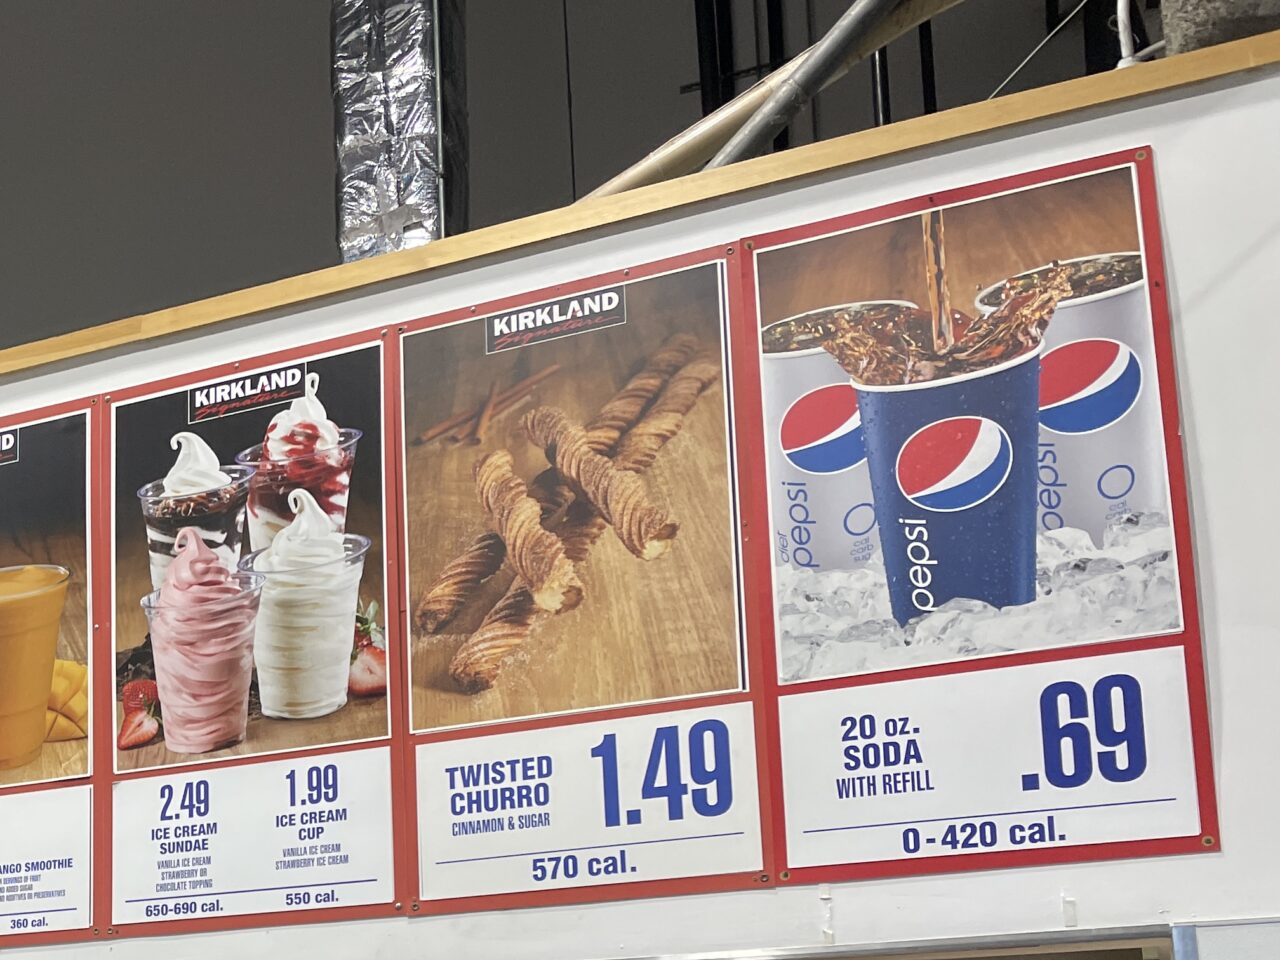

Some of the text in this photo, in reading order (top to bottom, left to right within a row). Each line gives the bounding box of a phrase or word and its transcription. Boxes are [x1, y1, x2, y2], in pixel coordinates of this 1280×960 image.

[493, 291, 619, 337] KIRKLAND
[195, 368, 301, 408] KIRKLAND
[781, 481, 820, 568] pepsi
[853, 536, 870, 547] cal
[898, 517, 938, 612] pepsi
[840, 714, 921, 742] 20 oz.
[1021, 674, 1148, 792] .69
[844, 739, 923, 771] SODA
[285, 764, 339, 807] 1.99
[445, 755, 553, 790] TWISTED
[590, 718, 733, 828] 1.49
[836, 770, 935, 800] WITH REFILL
[160, 780, 210, 821] 2.49
[451, 783, 550, 816] CHURRO
[151, 822, 218, 841] ICE CREAM
[275, 808, 347, 828] ICE CREAM
[451, 813, 550, 836] CINNAMON & SUGAR
[1009, 816, 1066, 844] cal.
[159, 839, 209, 855] SUNDAE
[298, 827, 324, 841] CUP
[157, 856, 211, 869] VANILLA ICE CREAM
[282, 844, 341, 857] VANILLA ICE CREAM
[317, 857, 326, 866] ICE
[328, 855, 349, 865] CREAM
[24, 858, 73, 872] SMOOTHIE
[532, 849, 637, 882] 570 cal.
[145, 899, 224, 917] 650-690 cal.
[285, 890, 339, 905] 550 cal.
[10, 916, 49, 929] 360 cal.
